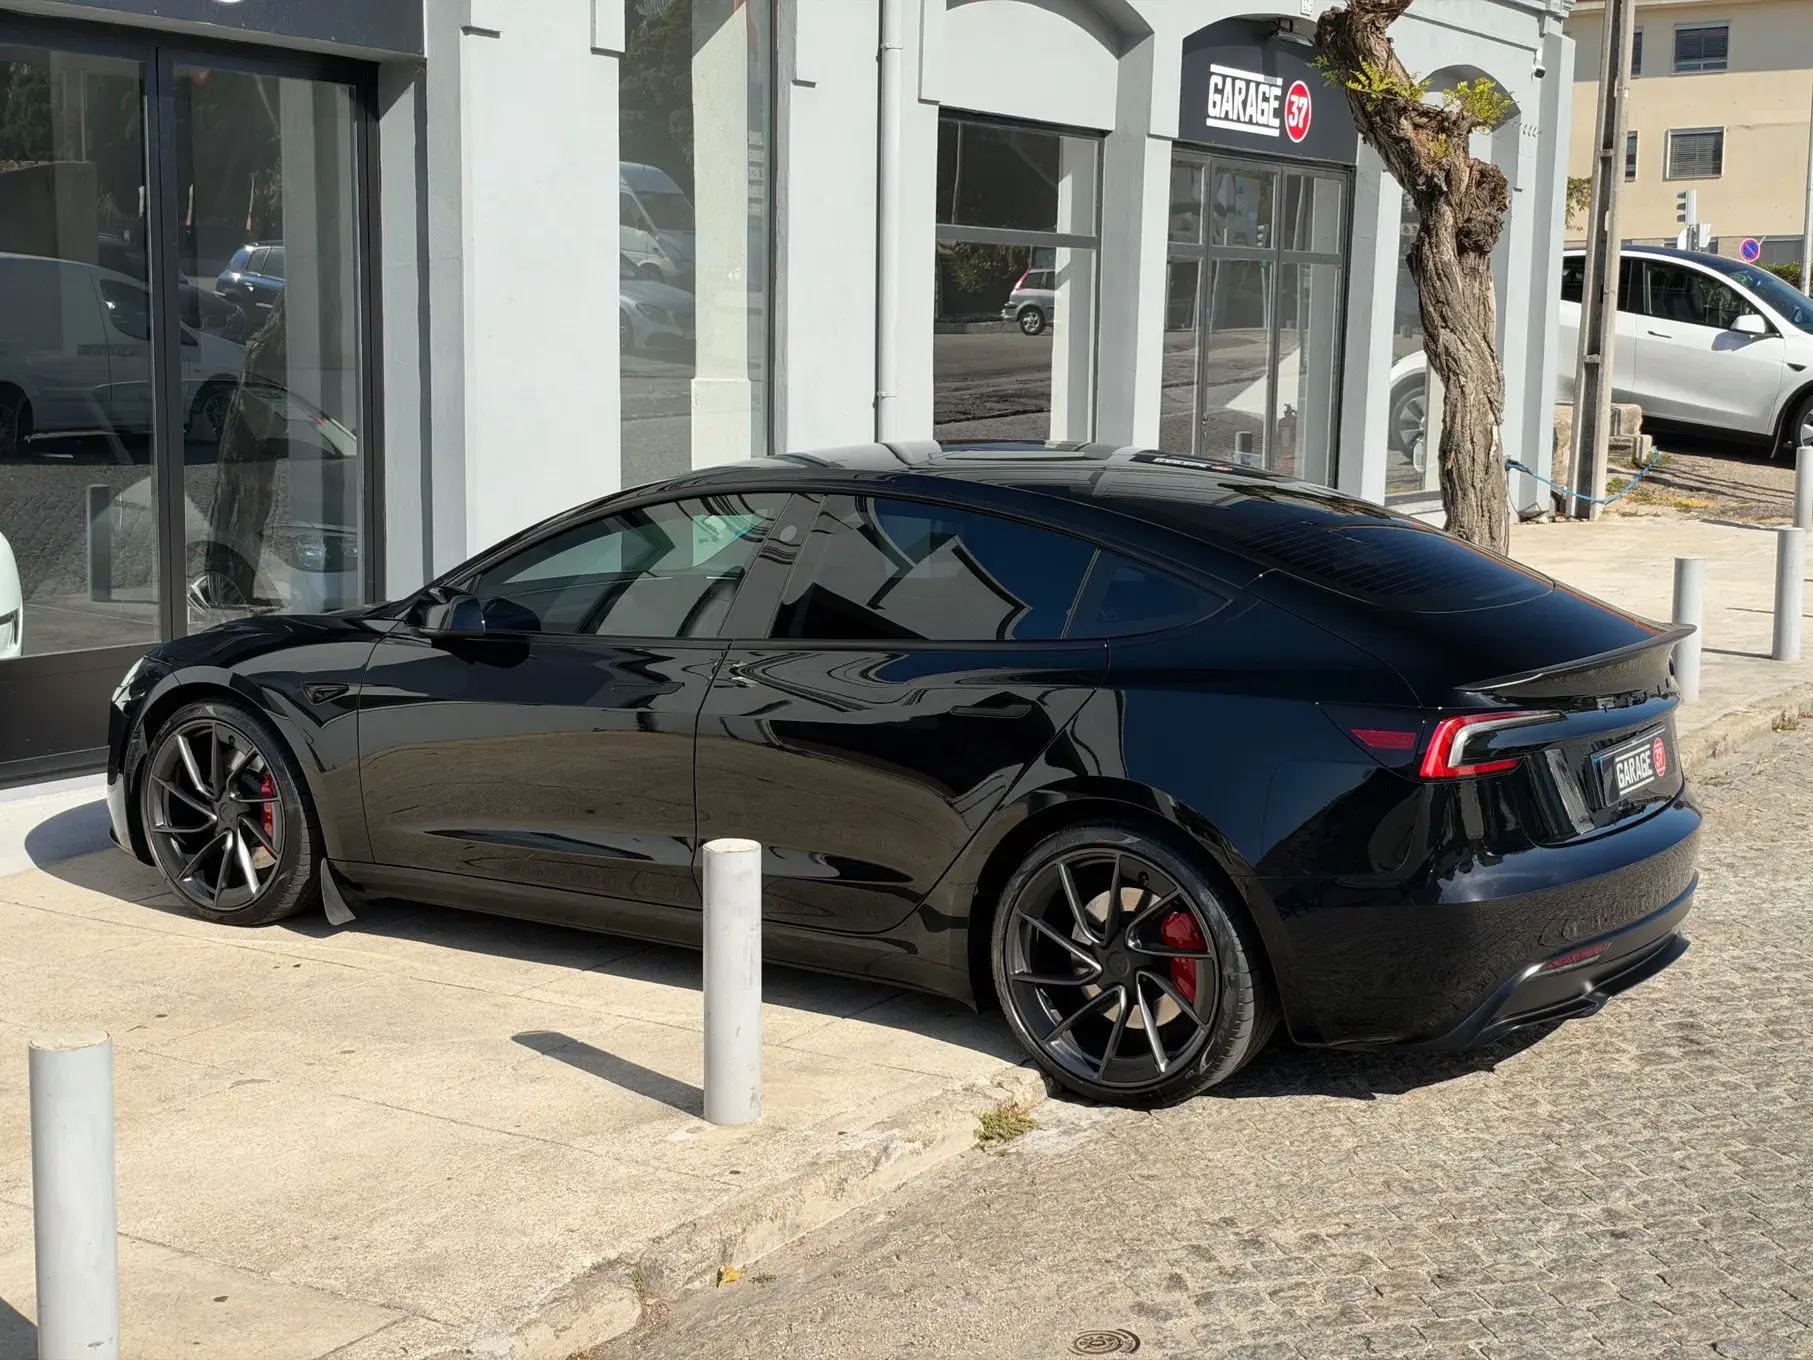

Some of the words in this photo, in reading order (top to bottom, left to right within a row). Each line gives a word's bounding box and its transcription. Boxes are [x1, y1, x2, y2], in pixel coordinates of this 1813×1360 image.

[1208, 75, 1281, 127] GARAGE
[1288, 95, 1308, 128] 37
[1616, 750, 1653, 788] GARAGE
